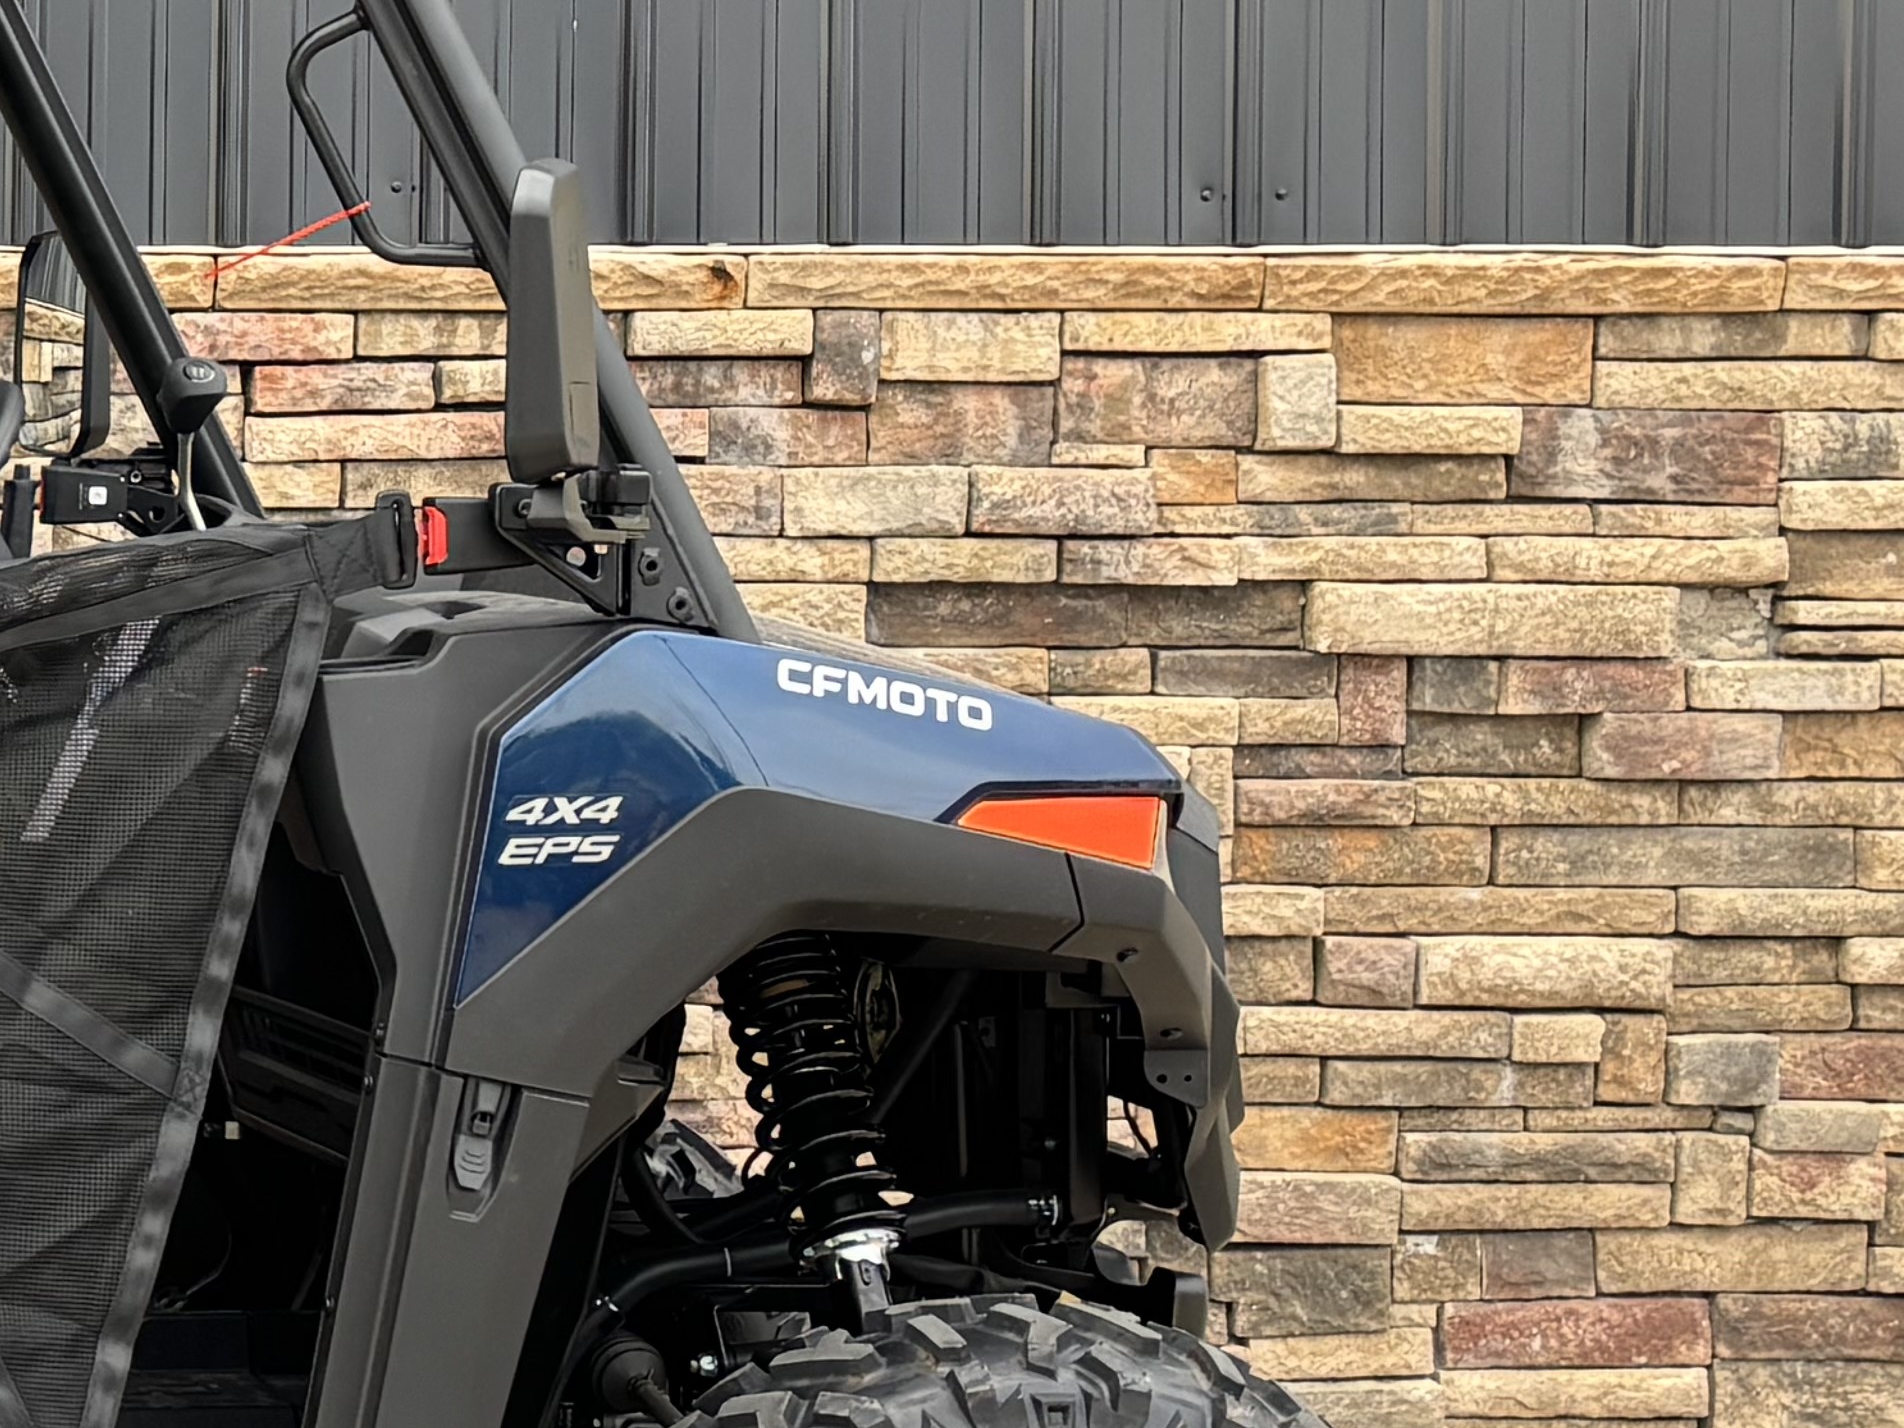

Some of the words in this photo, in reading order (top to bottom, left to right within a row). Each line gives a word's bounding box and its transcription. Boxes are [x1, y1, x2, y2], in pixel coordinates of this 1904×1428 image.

[777, 659, 992, 731] CFMOTO
[505, 796, 623, 825] 4X4
[498, 835, 620, 865] EPS
